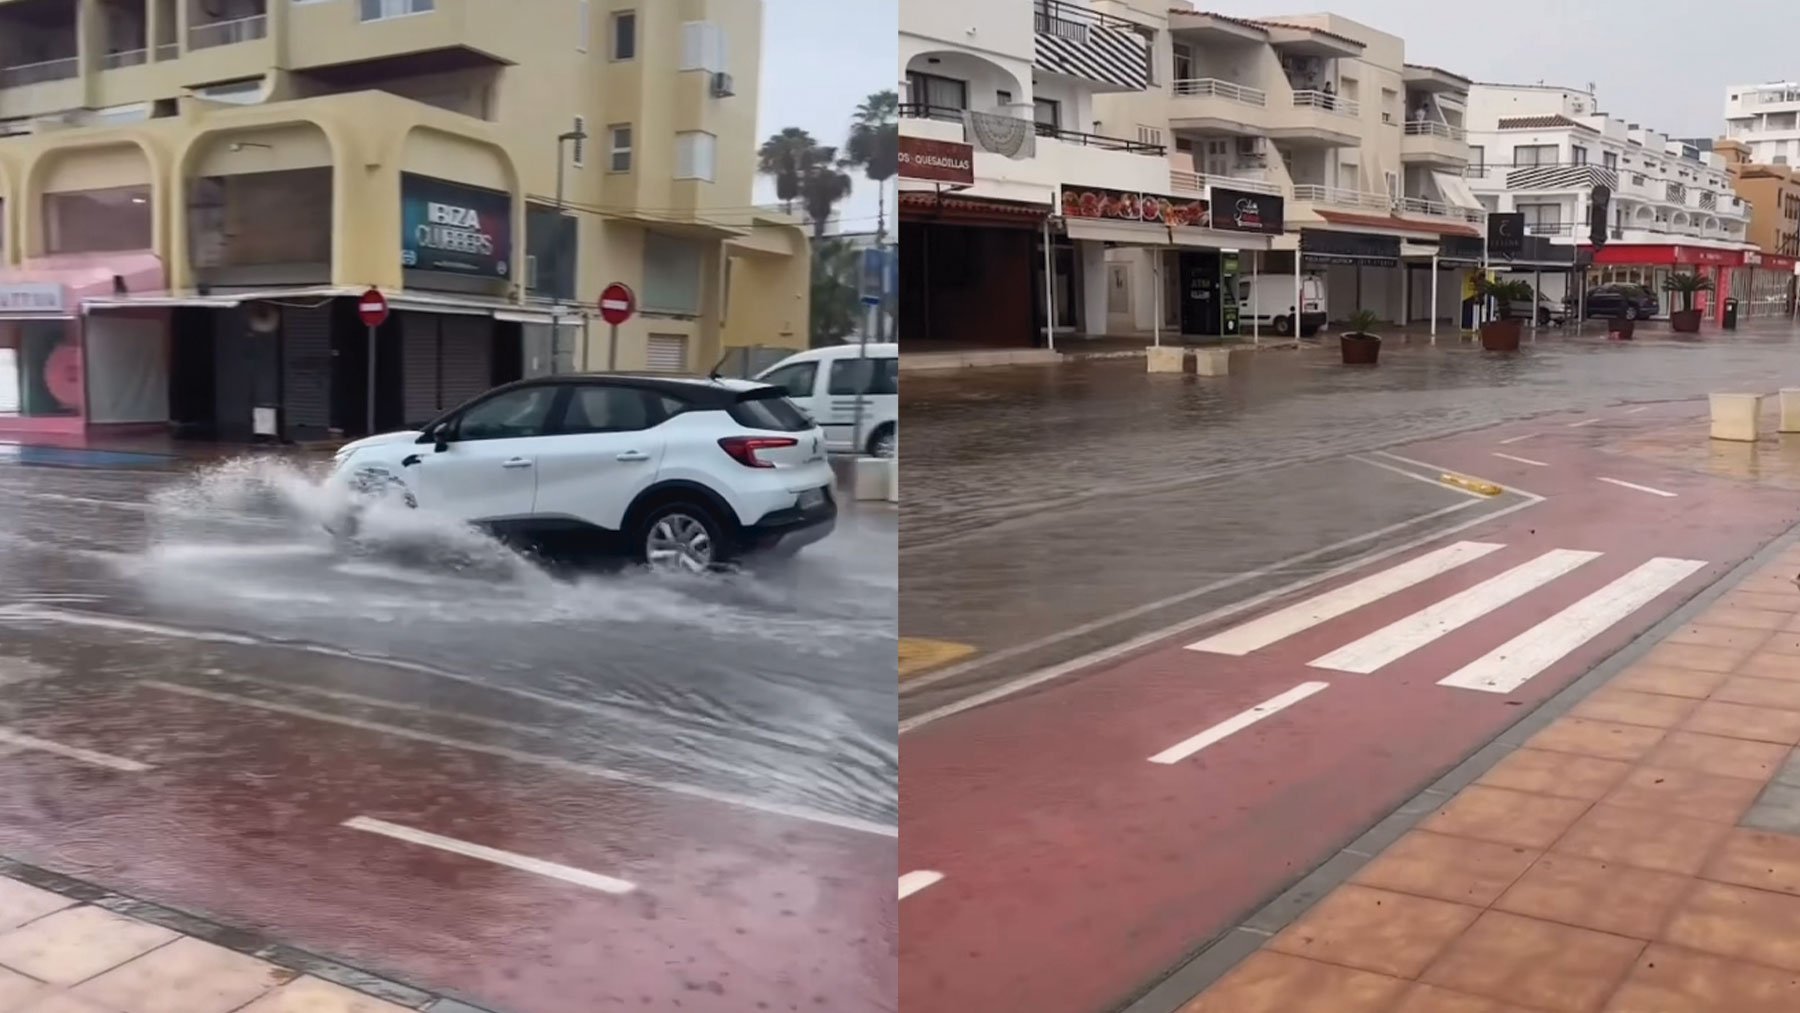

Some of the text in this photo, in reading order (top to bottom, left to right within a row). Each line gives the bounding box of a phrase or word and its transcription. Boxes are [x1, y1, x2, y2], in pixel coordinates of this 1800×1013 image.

[915, 155, 969, 169] QUESADILLAS
[427, 202, 480, 229] IBIZA
[415, 224, 493, 255] CLUBBERS
